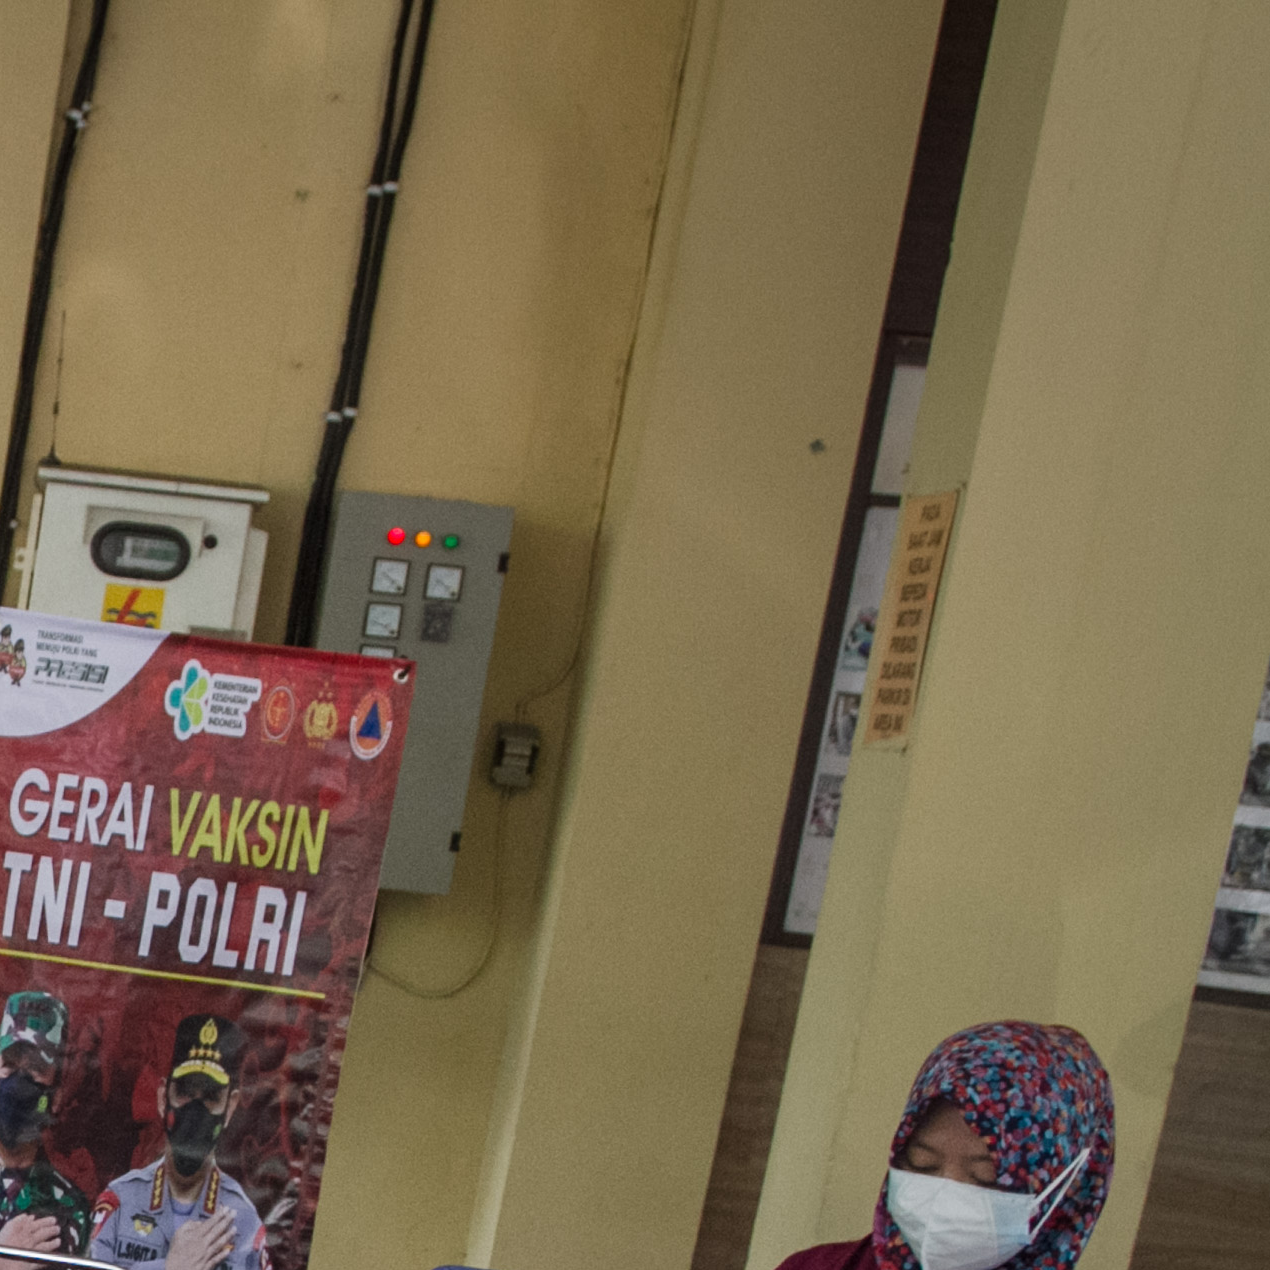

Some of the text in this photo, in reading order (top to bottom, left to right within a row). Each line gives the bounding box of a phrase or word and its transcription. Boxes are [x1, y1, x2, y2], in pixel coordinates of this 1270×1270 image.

[38, 629, 84, 644] TRANSFORMASI
[36, 642, 61, 654] MENUJU
[82, 648, 98, 657] YANG
[214, 681, 258, 694] KEMENTERIAN
[212, 693, 248, 705] KESEHATAN
[210, 704, 239, 716] REPUBLIK
[208, 717, 242, 729] INDONESIA
[9, 768, 329, 874] GERAI VAKSIN
[2, 851, 91, 947] TNI
[137, 871, 307, 976] POLRI
